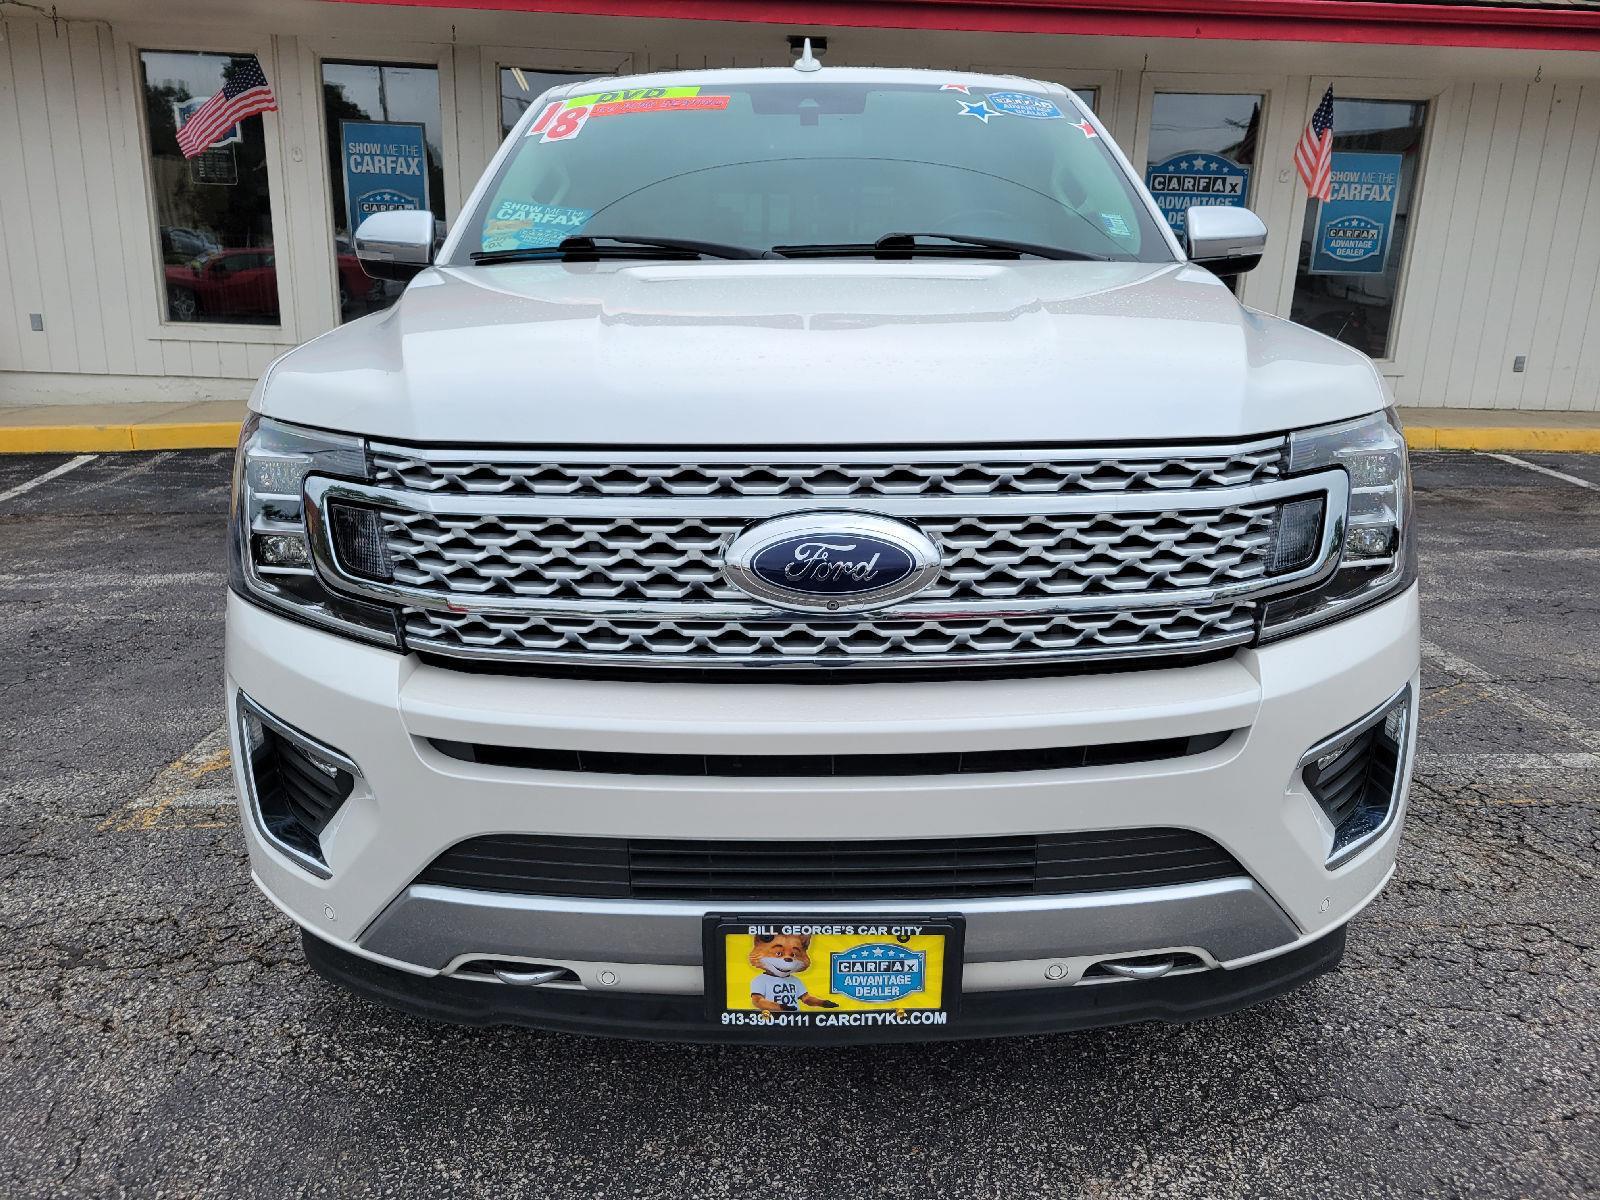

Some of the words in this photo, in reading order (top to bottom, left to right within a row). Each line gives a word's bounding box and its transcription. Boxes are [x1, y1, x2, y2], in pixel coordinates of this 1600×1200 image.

[597, 88, 667, 103] DVD
[531, 101, 588, 140] 18
[349, 142, 380, 155] SHOW
[384, 144, 399, 156] ME
[400, 144, 419, 157] THE
[350, 155, 420, 176] CARFAX
[1331, 171, 1360, 182] SHOW
[1362, 172, 1377, 183] ME
[1378, 173, 1396, 184] THE
[1153, 176, 1239, 194] CARFAX
[1331, 183, 1391, 201] CARFAX
[502, 201, 542, 213] SHOW
[1158, 196, 1233, 209] ADVANTAGE
[497, 208, 586, 226] CARFAX
[1330, 230, 1377, 240] CARFAX
[1330, 239, 1372, 249] ADVANTAGE
[1336, 248, 1364, 256] DEALER
[784, 542, 881, 582] Ford
[748, 925, 778, 936] BILL
[781, 925, 855, 936] GEORGE'S
[858, 926, 888, 937] CAR
[891, 926, 923, 936] CITY
[840, 961, 915, 973] CARFAX
[844, 974, 912, 986] ADVANTAGE
[773, 983, 796, 995] CAR
[855, 986, 900, 997] DEALER
[773, 994, 797, 1005] FOX
[721, 1012, 810, 1027] 913-390-0111
[815, 1011, 948, 1027] CARCITYKC.COM
